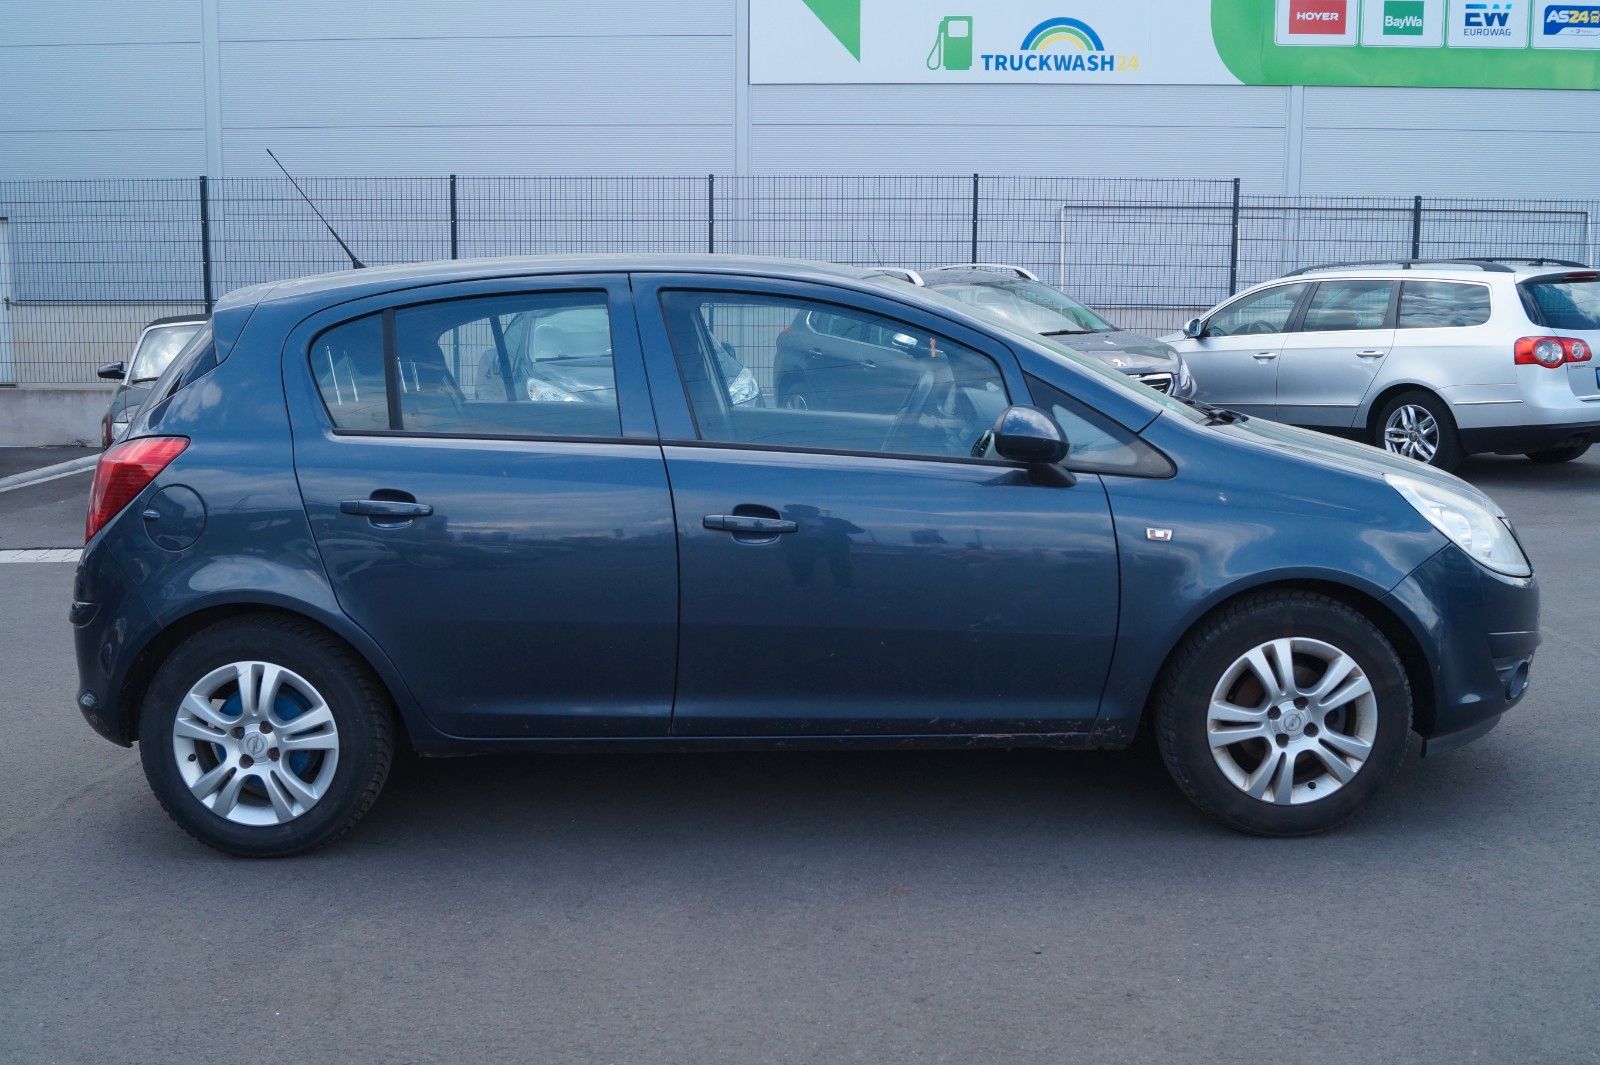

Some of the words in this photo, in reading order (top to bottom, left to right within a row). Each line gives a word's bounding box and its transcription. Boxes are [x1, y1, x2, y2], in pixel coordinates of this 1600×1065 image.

[1296, 12, 1339, 21] HOYER
[1385, 15, 1423, 28] BayWa
[1464, 28, 1511, 36] EUROWAG
